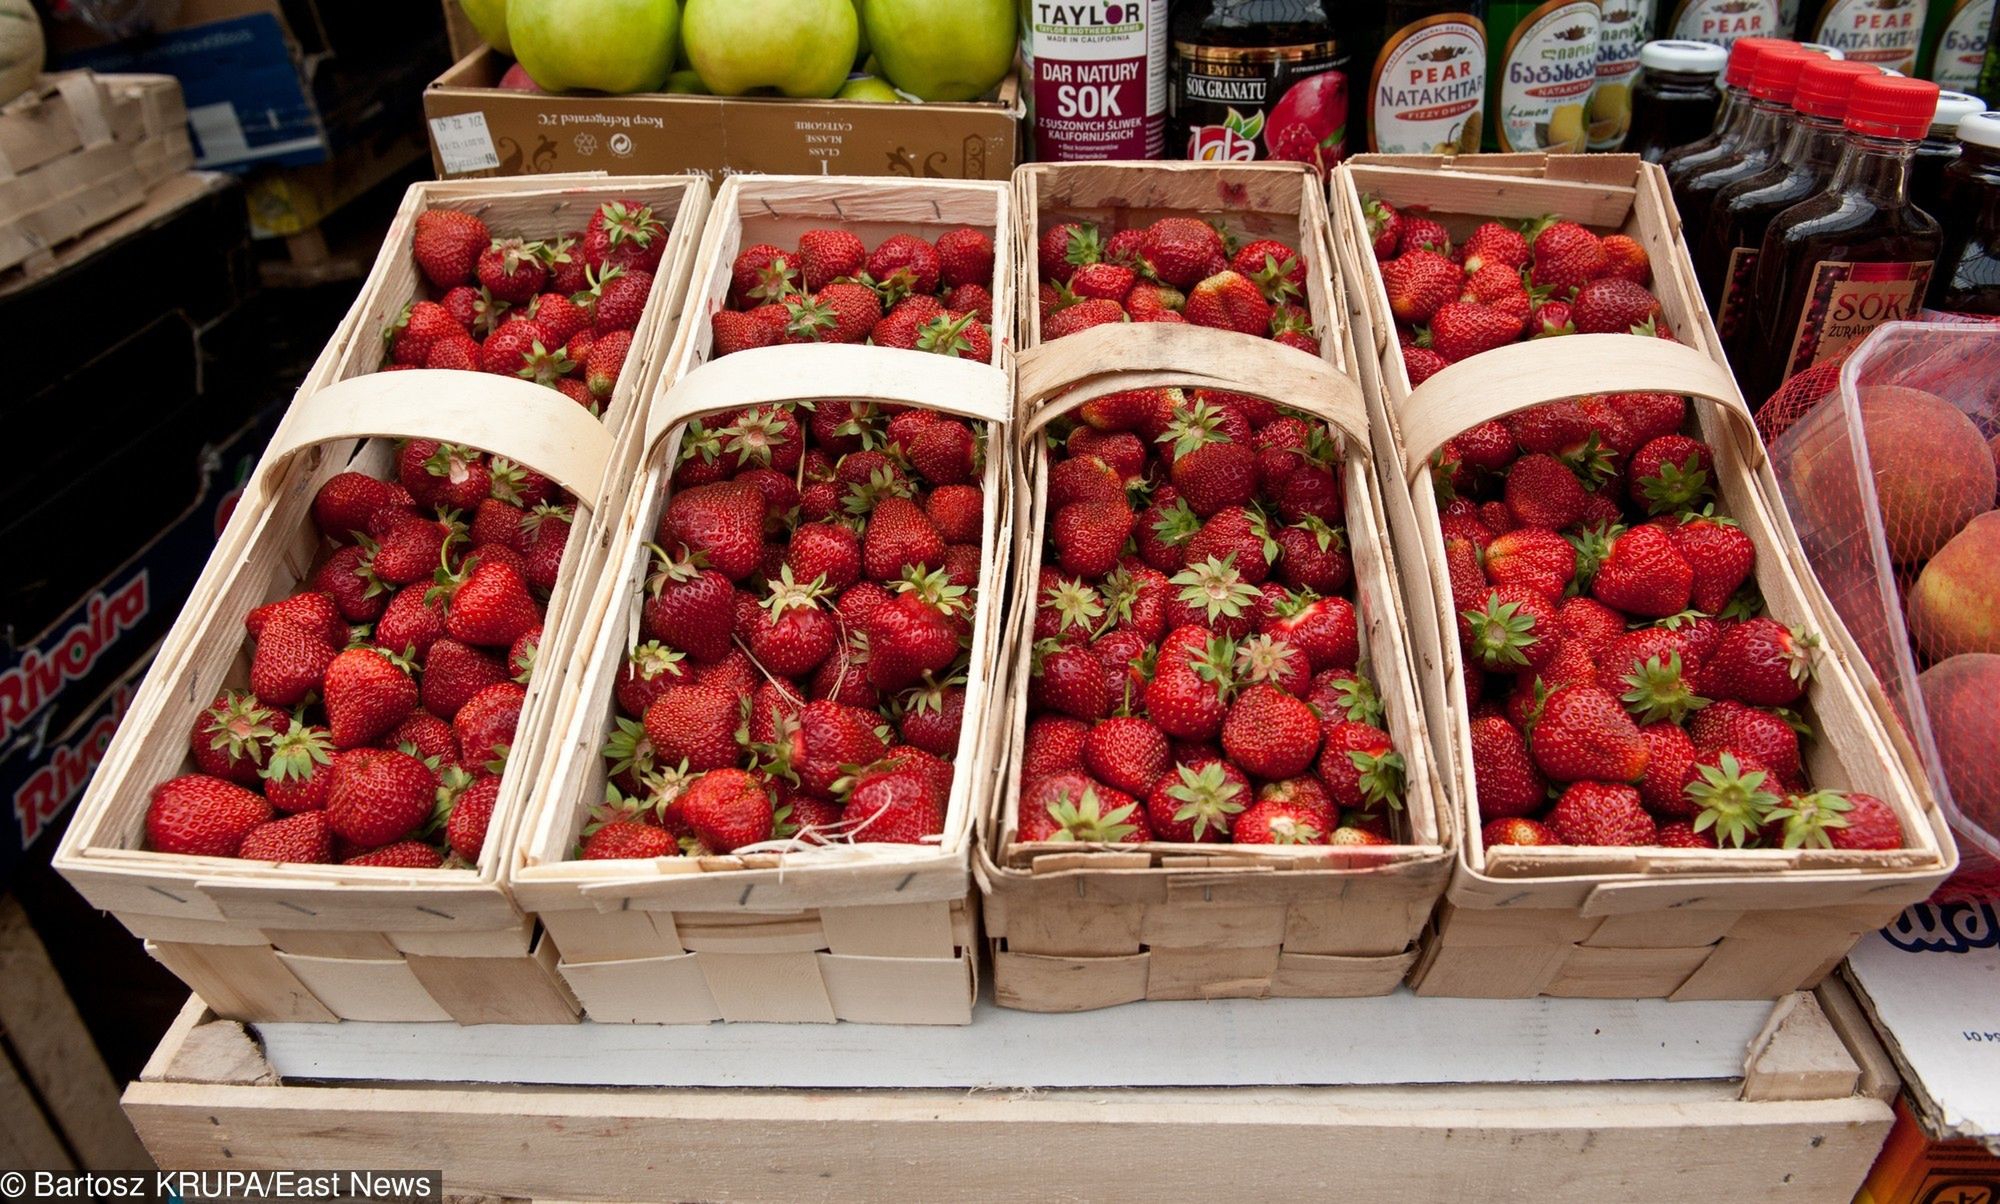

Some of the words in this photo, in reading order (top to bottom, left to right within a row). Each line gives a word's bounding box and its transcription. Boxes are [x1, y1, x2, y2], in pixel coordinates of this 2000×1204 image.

[1038, 3, 1140, 25] TAYLOR
[1853, 12, 1913, 29] PEAR
[1703, 15, 1763, 34] PEAR
[1047, 35, 1067, 43] MADE
[1070, 35, 1079, 43] IN
[1080, 35, 1131, 43] CALIFORNIA
[1042, 62, 1073, 82] DAR
[1077, 61, 1139, 83] NATURY
[1409, 61, 1472, 85] PEAR
[1186, 77, 1206, 97] SOK
[1207, 80, 1267, 100] GRANATU
[1058, 84, 1122, 118] SOK
[1408, 111, 1440, 119] FIZZY
[1441, 103, 1473, 116] DRINK
[561, 114, 630, 128] Refrigerated
[633, 115, 664, 128] Keep
[795, 121, 853, 131] CATEGORIE
[1039, 117, 1046, 127] Z
[1046, 118, 1105, 131] SUSZONYCH
[1107, 116, 1143, 130] ŚLIWEK
[805, 135, 843, 144] KLASSE
[1048, 129, 1134, 142] KALIFORNIJSKICH
[809, 148, 840, 157] CLASS
[1833, 292, 1909, 321] SOK
[0, 567, 149, 745] Rivoira
